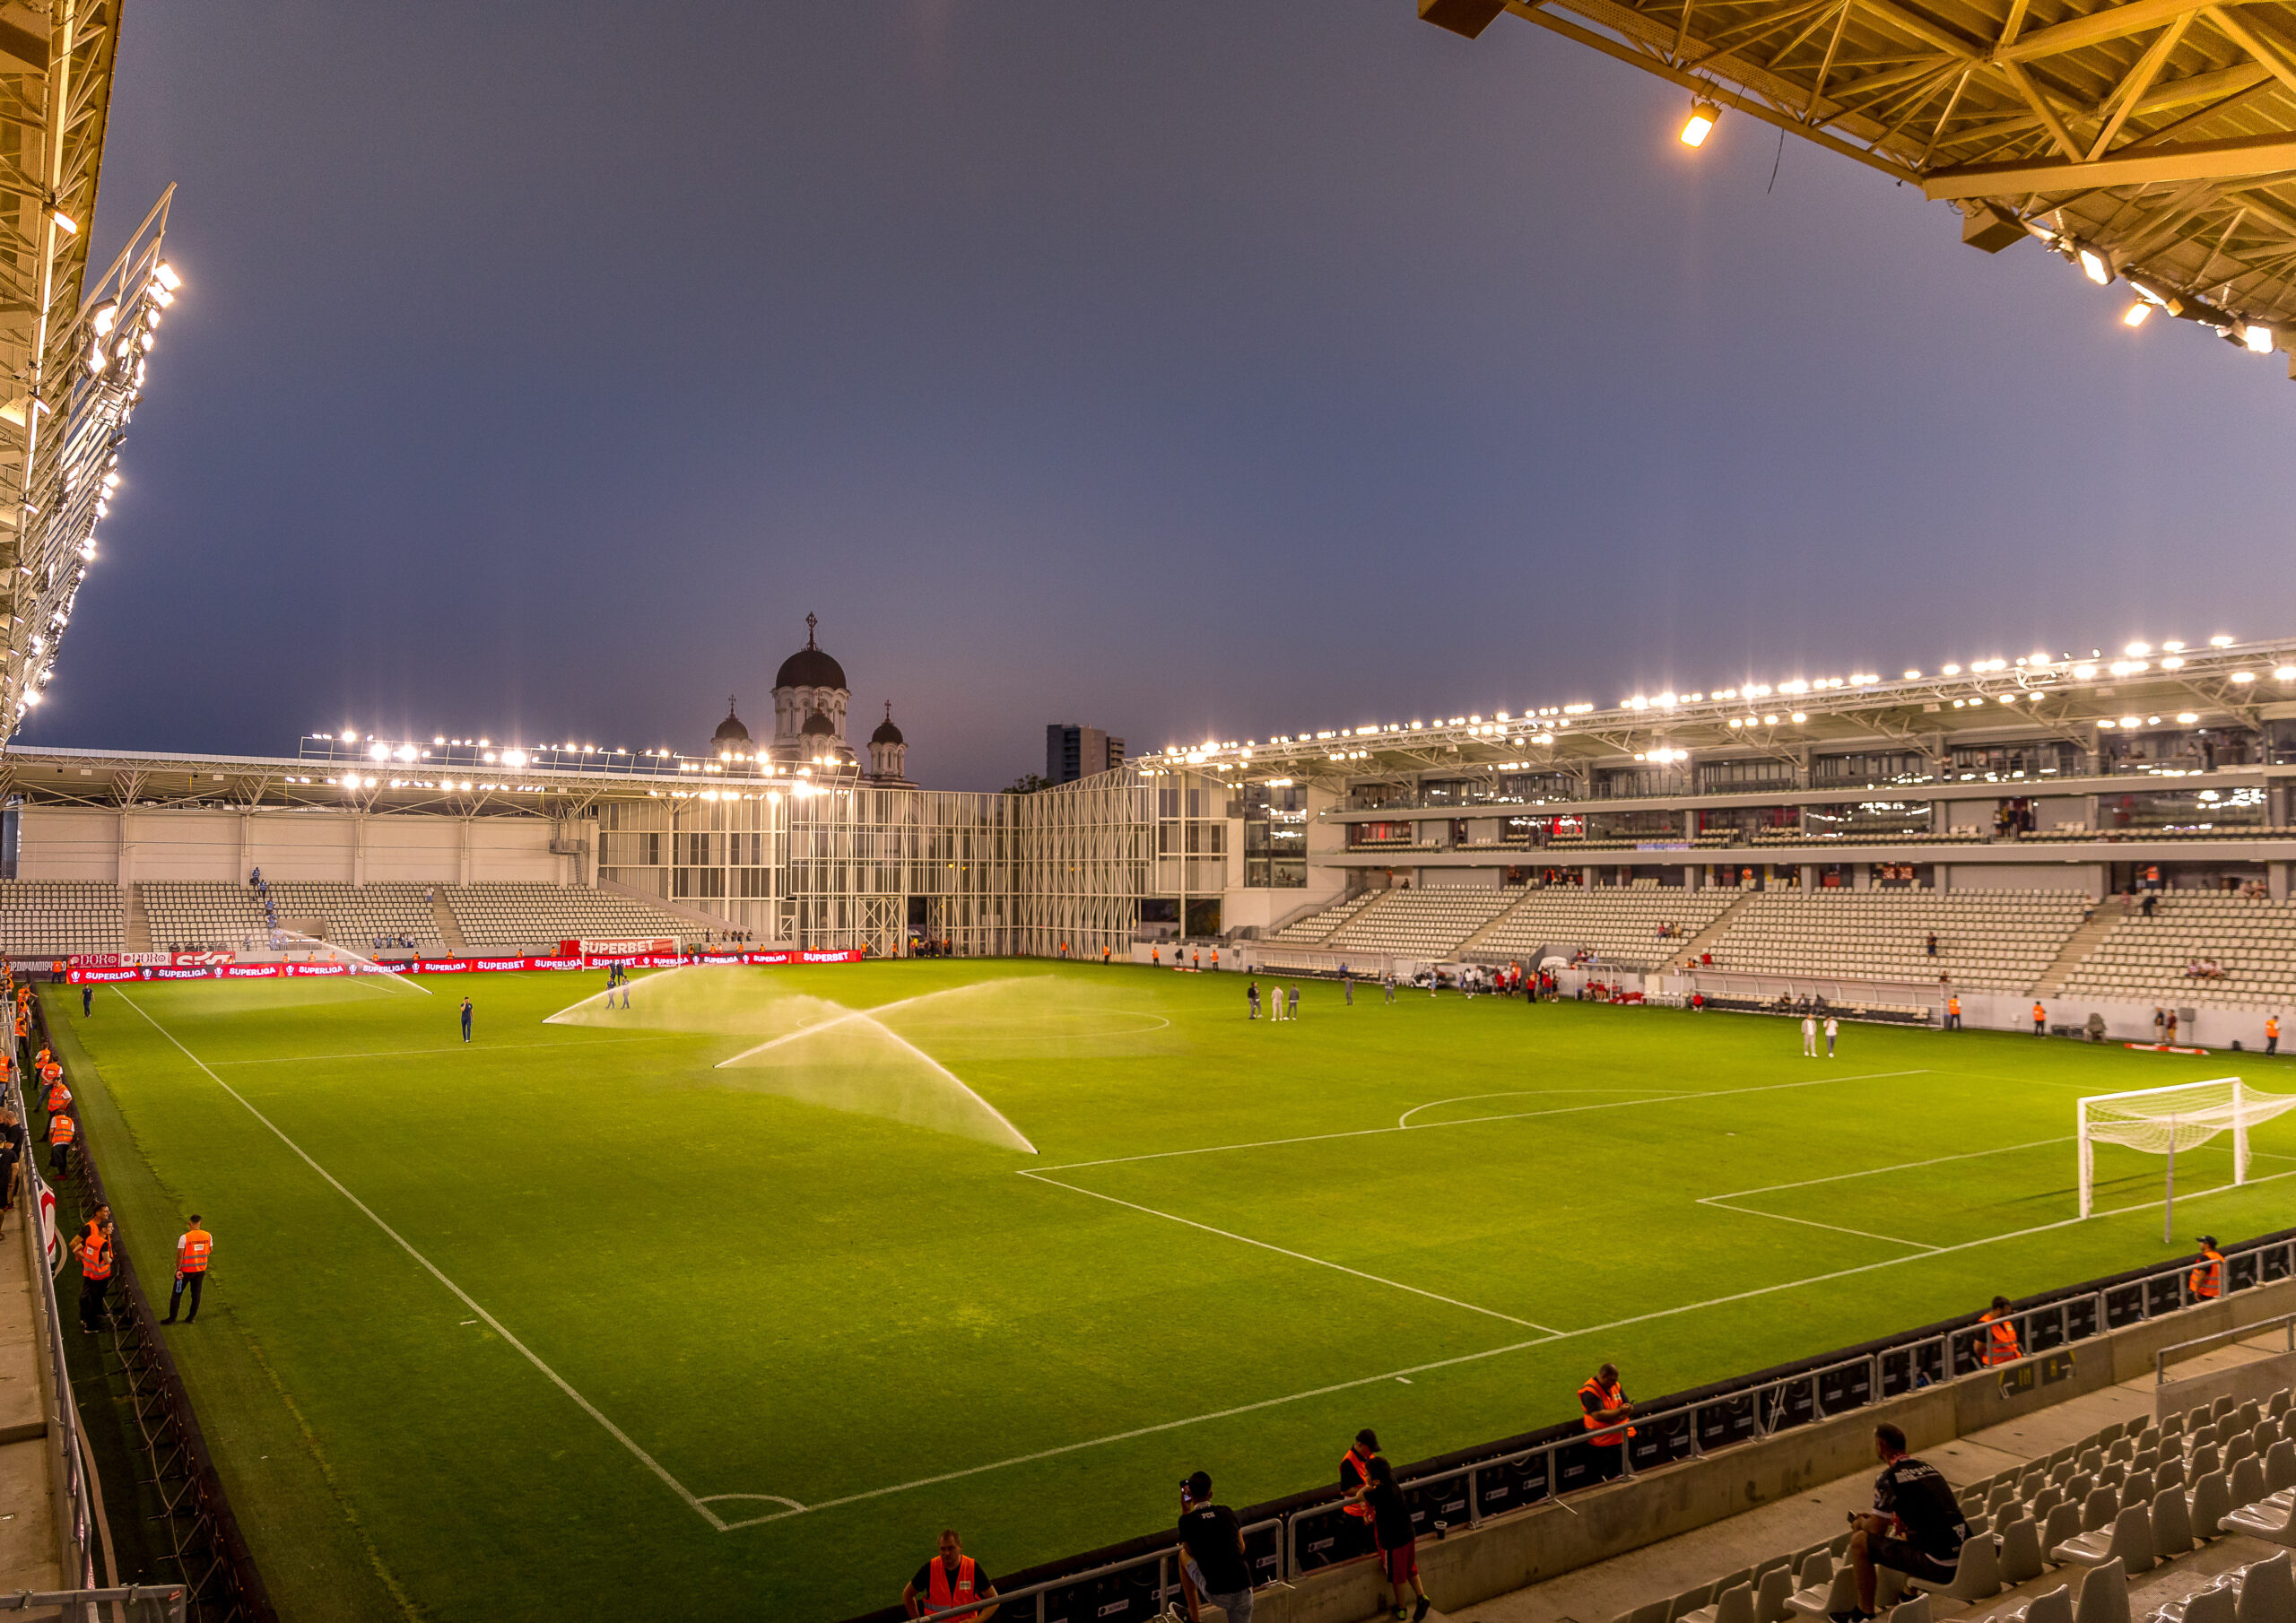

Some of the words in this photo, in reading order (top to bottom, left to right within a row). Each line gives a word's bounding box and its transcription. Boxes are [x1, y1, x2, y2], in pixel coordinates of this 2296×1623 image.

[578, 939, 655, 954] SUPERBET
[703, 955, 739, 964] SUPERLIGA
[753, 954, 787, 963] SUPERLIGA
[804, 951, 849, 962] SUPERBET
[425, 962, 466, 971] SUPERLIGA
[477, 960, 525, 969] SUPERBET
[535, 959, 583, 968] SUPERLIGA
[158, 968, 207, 978] SUPERLIGA
[229, 967, 276, 976] SUPERLIGA
[299, 965, 344, 975] SUPERLIGA
[362, 964, 406, 973] SUPERLIGA
[85, 970, 136, 980] SUPERLIGA
